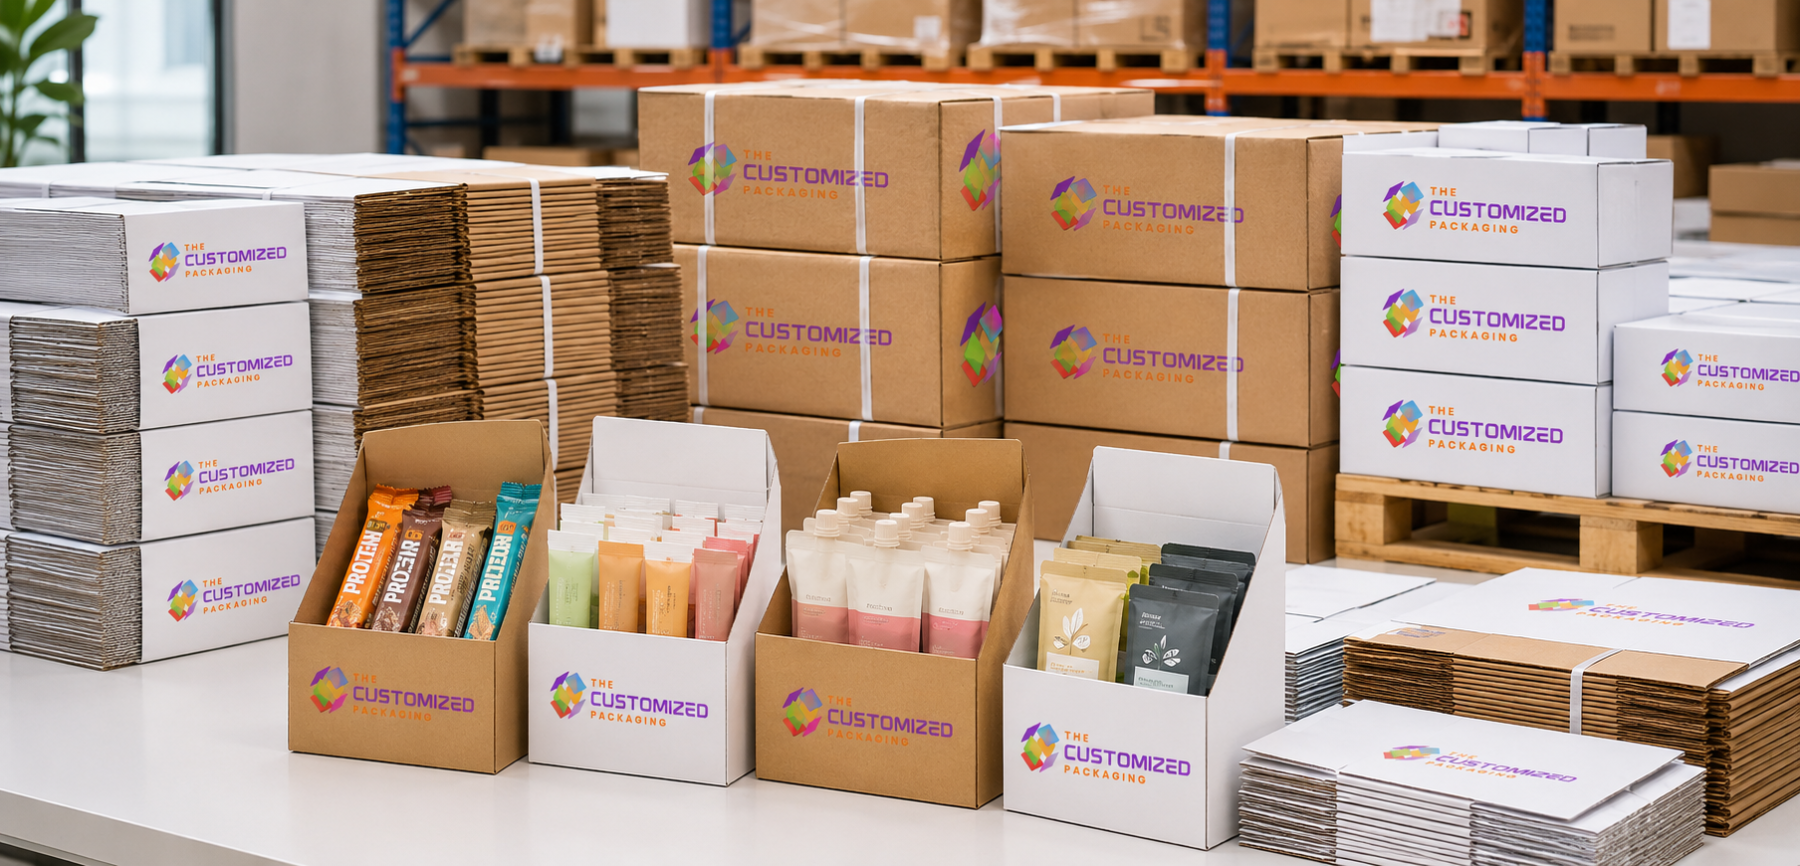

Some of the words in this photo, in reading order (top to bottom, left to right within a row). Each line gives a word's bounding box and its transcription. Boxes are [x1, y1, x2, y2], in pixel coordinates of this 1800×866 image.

[743, 150, 772, 160] THE
[743, 164, 889, 189] CUSTOMIZED
[743, 186, 838, 200] PACKAGING
[1103, 185, 1130, 196] THE
[1430, 186, 1457, 197] THE
[1103, 199, 1244, 224] CUSTOMIZED
[1429, 200, 1567, 224] CUSTOMIZED
[1103, 220, 1194, 235] PACKAGING
[1429, 220, 1519, 235] PACKAGING
[184, 242, 205, 251] THE
[185, 246, 287, 267] CUSTOMIZED
[185, 265, 253, 278] PACKAGING
[1429, 294, 1456, 305] THE
[745, 307, 774, 317] THE
[1429, 308, 1566, 333] CUSTOMIZED
[745, 321, 893, 347] CUSTOMIZED
[1103, 333, 1130, 344] THE
[1429, 328, 1518, 342] PACKAGING
[196, 353, 216, 362] THE
[745, 343, 841, 358] PACKAGING
[1698, 354, 1719, 362] THE
[196, 355, 293, 378] CUSTOMIZED
[1103, 347, 1244, 374] CUSTOMIZED
[197, 374, 261, 388] PACKAGING
[1103, 369, 1194, 384] PACKAGING
[1697, 364, 1800, 383] CUSTOMIZED
[1697, 380, 1765, 391] PACKAGING
[1428, 405, 1455, 416] THE
[1428, 419, 1564, 445] CUSTOMIZED
[1428, 439, 1516, 454] PACKAGING
[1697, 445, 1718, 453] THE
[198, 459, 218, 468] THE
[198, 458, 295, 484] CUSTOMIZED
[1696, 455, 1800, 474] CUSTOMIZED
[1696, 470, 1764, 482] PACKAGING
[199, 478, 263, 495] PACKAGING
[203, 577, 223, 587] THE
[203, 574, 300, 603] CUSTOMIZED
[203, 595, 268, 614] PACKAGING
[1588, 606, 1756, 628] CUSTOMIZED
[353, 673, 377, 683] THE
[591, 678, 614, 689] THE
[353, 686, 475, 713] CUSTOMIZED
[590, 691, 709, 719] CUSTOMIZED
[828, 695, 853, 706] THE
[353, 704, 432, 721] PACKAGING
[590, 709, 667, 727] PACKAGING
[827, 708, 953, 738] CUSTOMIZED
[827, 727, 909, 747] PACKAGING
[1064, 731, 1089, 743] THE
[1063, 744, 1191, 776] CUSTOMIZED
[1063, 764, 1147, 784] PACKAGING
[1435, 755, 1578, 783] CUSTOMIZED
